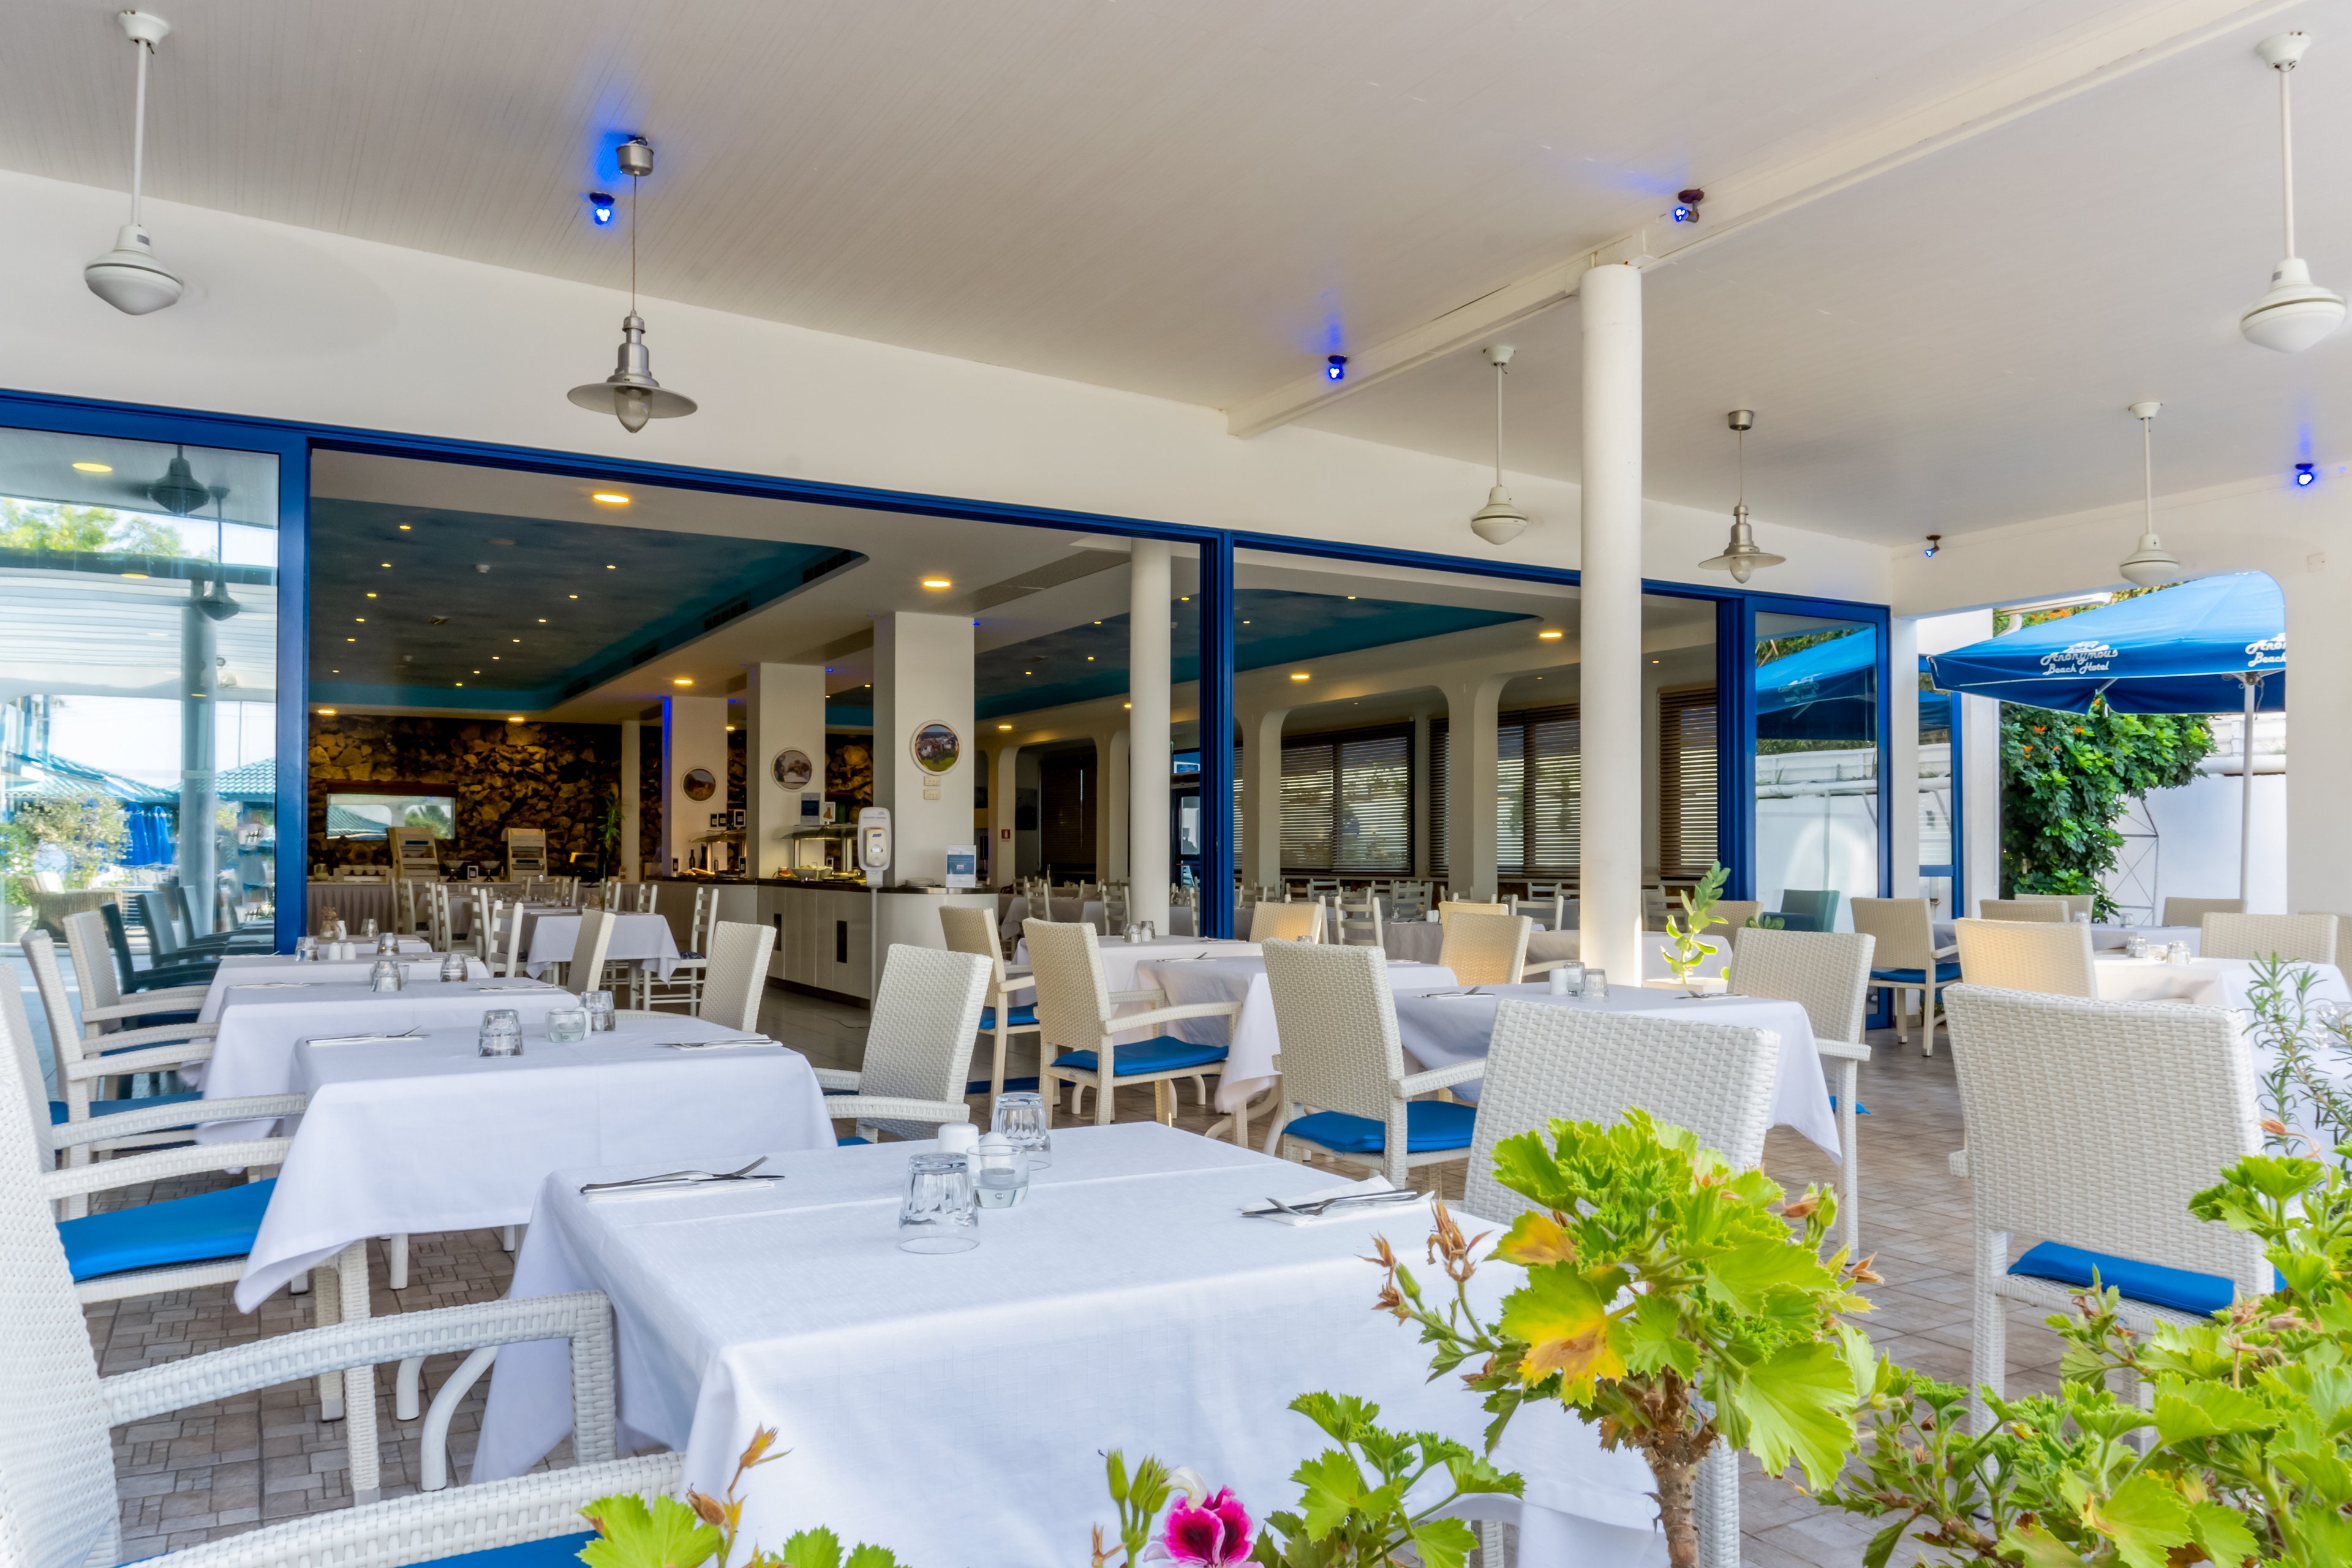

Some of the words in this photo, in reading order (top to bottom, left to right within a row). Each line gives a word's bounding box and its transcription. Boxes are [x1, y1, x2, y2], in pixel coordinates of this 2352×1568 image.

[2040, 649, 2118, 666] Anonymous
[2042, 663, 2077, 675] Beach
[2079, 661, 2109, 674] Hotel
